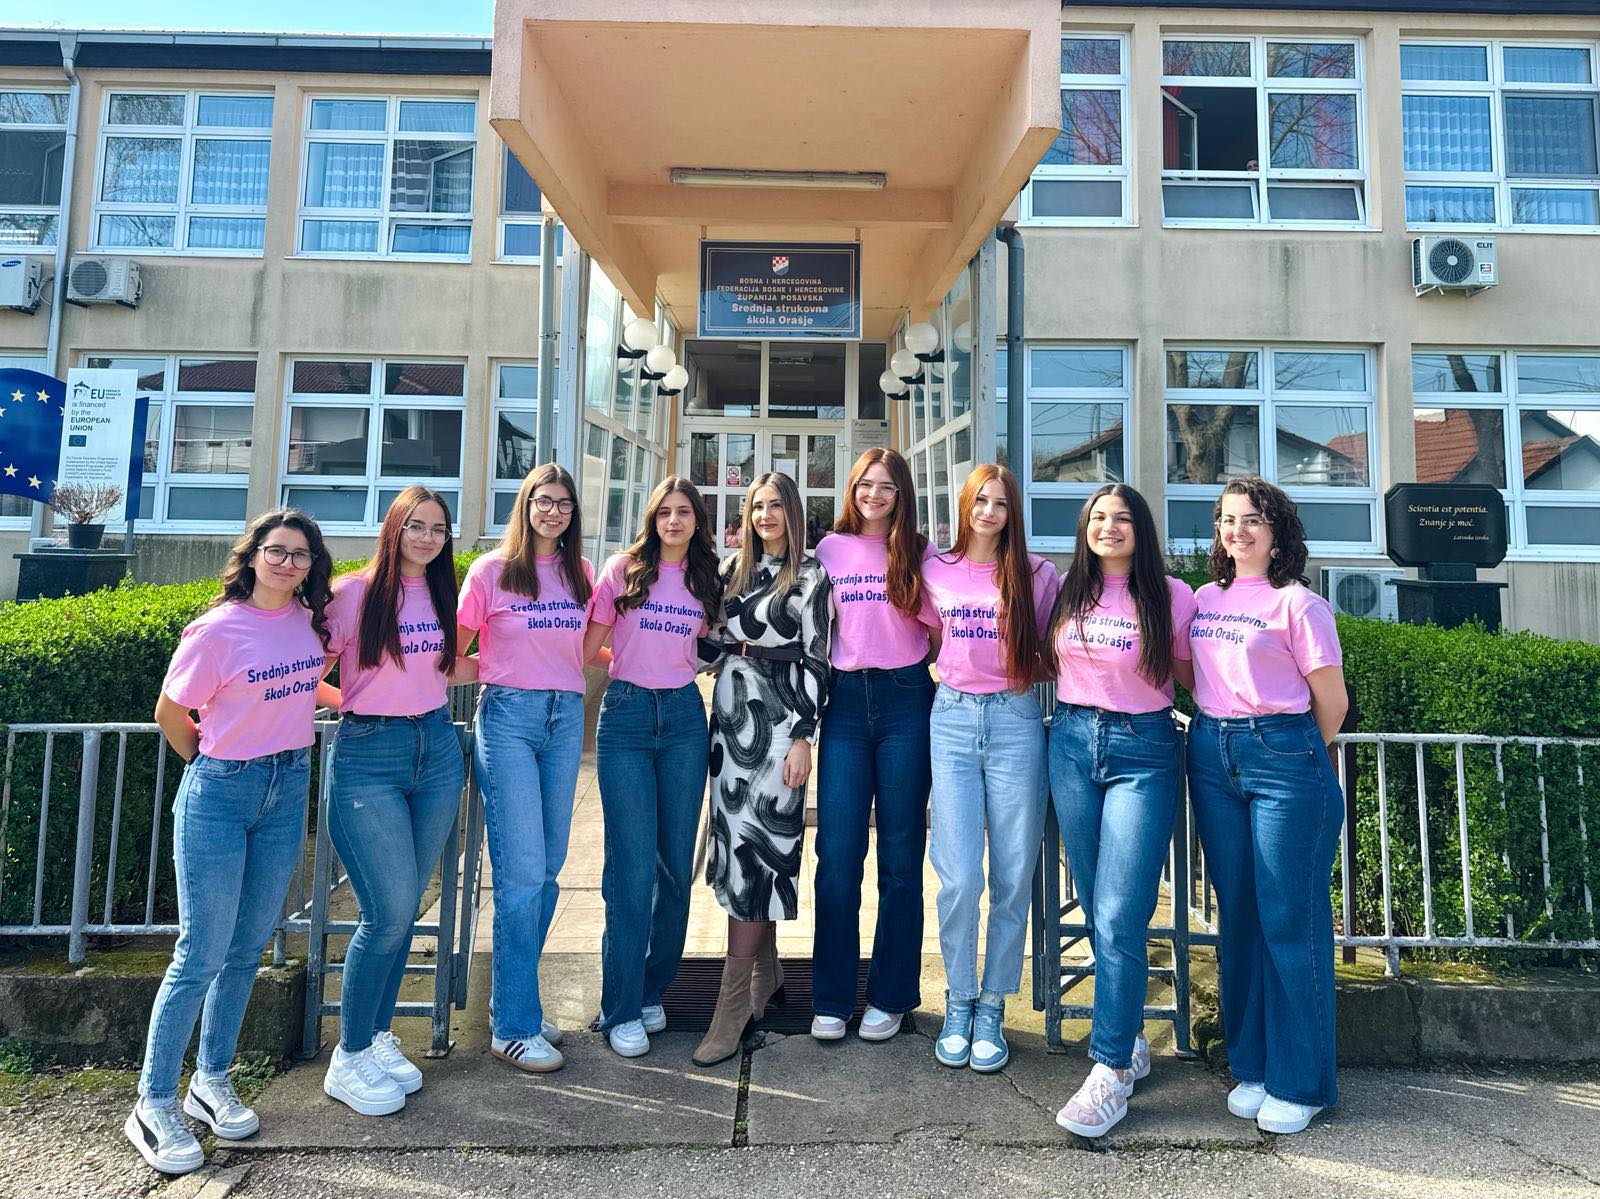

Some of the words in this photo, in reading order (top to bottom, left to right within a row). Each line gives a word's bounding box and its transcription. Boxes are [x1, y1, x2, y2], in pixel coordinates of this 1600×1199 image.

[716, 285, 759, 293] FEDERACIJA
[737, 293, 777, 301] ŽUPANIJA
[731, 303, 773, 314] Srednja
[776, 303, 829, 313] strukovna
[747, 315, 775, 325] škola
[779, 315, 814, 326] Orašje
[91, 389, 105, 399] EU
[1408, 504, 1440, 513] Scientia
[1419, 518, 1447, 529] Znanje
[1447, 520, 1456, 529] je
[831, 573, 863, 586] Srednja
[840, 590, 864, 603] škola
[866, 590, 890, 604] Orašj
[511, 601, 546, 613] Srednja
[665, 605, 705, 620] strukovna
[416, 619, 443, 633] struk
[528, 617, 552, 629] škola
[554, 617, 581, 631] Orašje
[1098, 616, 1138, 631] strukov
[1196, 611, 1221, 622] ednja
[1221, 613, 1268, 629] strukovna
[640, 618, 663, 631] škola
[664, 621, 692, 637] Orašje
[951, 626, 975, 638] škola
[1097, 633, 1133, 651] Orašje
[1191, 626, 1214, 638] škola
[1215, 627, 1245, 645] Orašje
[247, 662, 290, 683] Srednja
[292, 655, 326, 673] strukov
[264, 685, 290, 701] škola
[292, 676, 319, 694] Orašj
